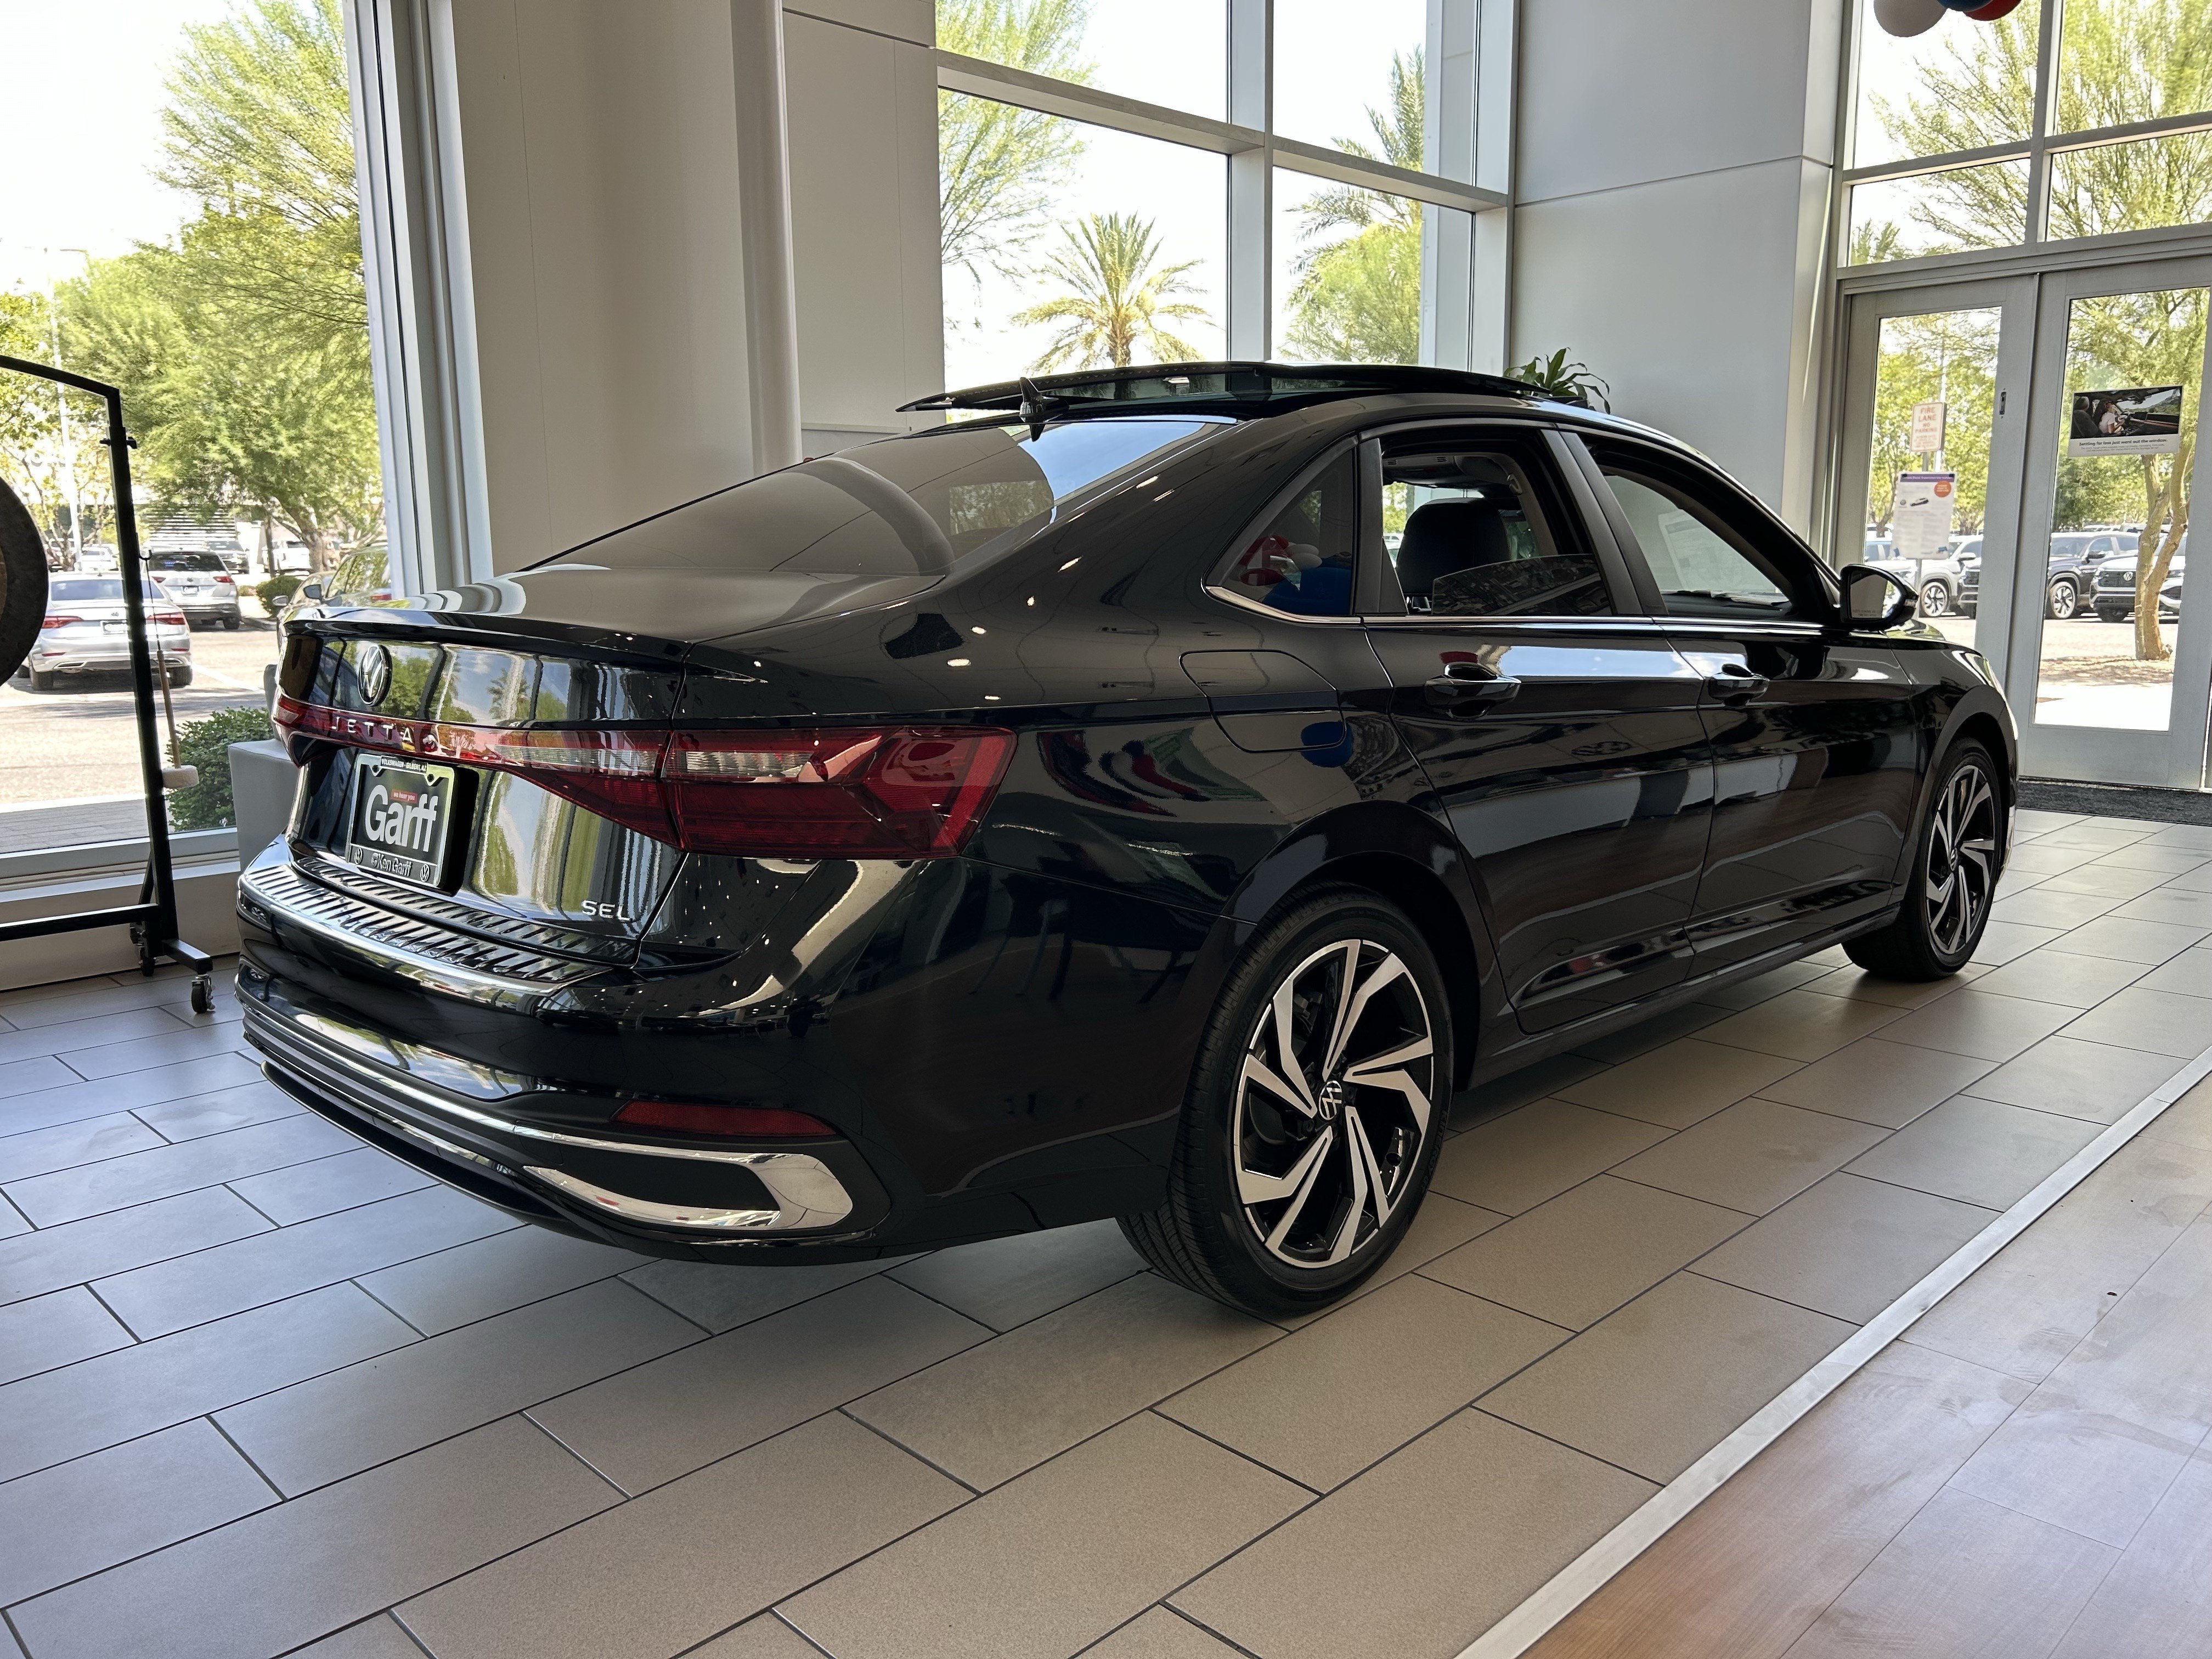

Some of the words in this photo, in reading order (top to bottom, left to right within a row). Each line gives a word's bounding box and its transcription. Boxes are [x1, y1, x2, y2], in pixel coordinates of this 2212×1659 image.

[331, 716, 414, 743] JETTA
[365, 785, 438, 852] Garff
[392, 858, 412, 876] Garff
[582, 900, 630, 920] SEL
